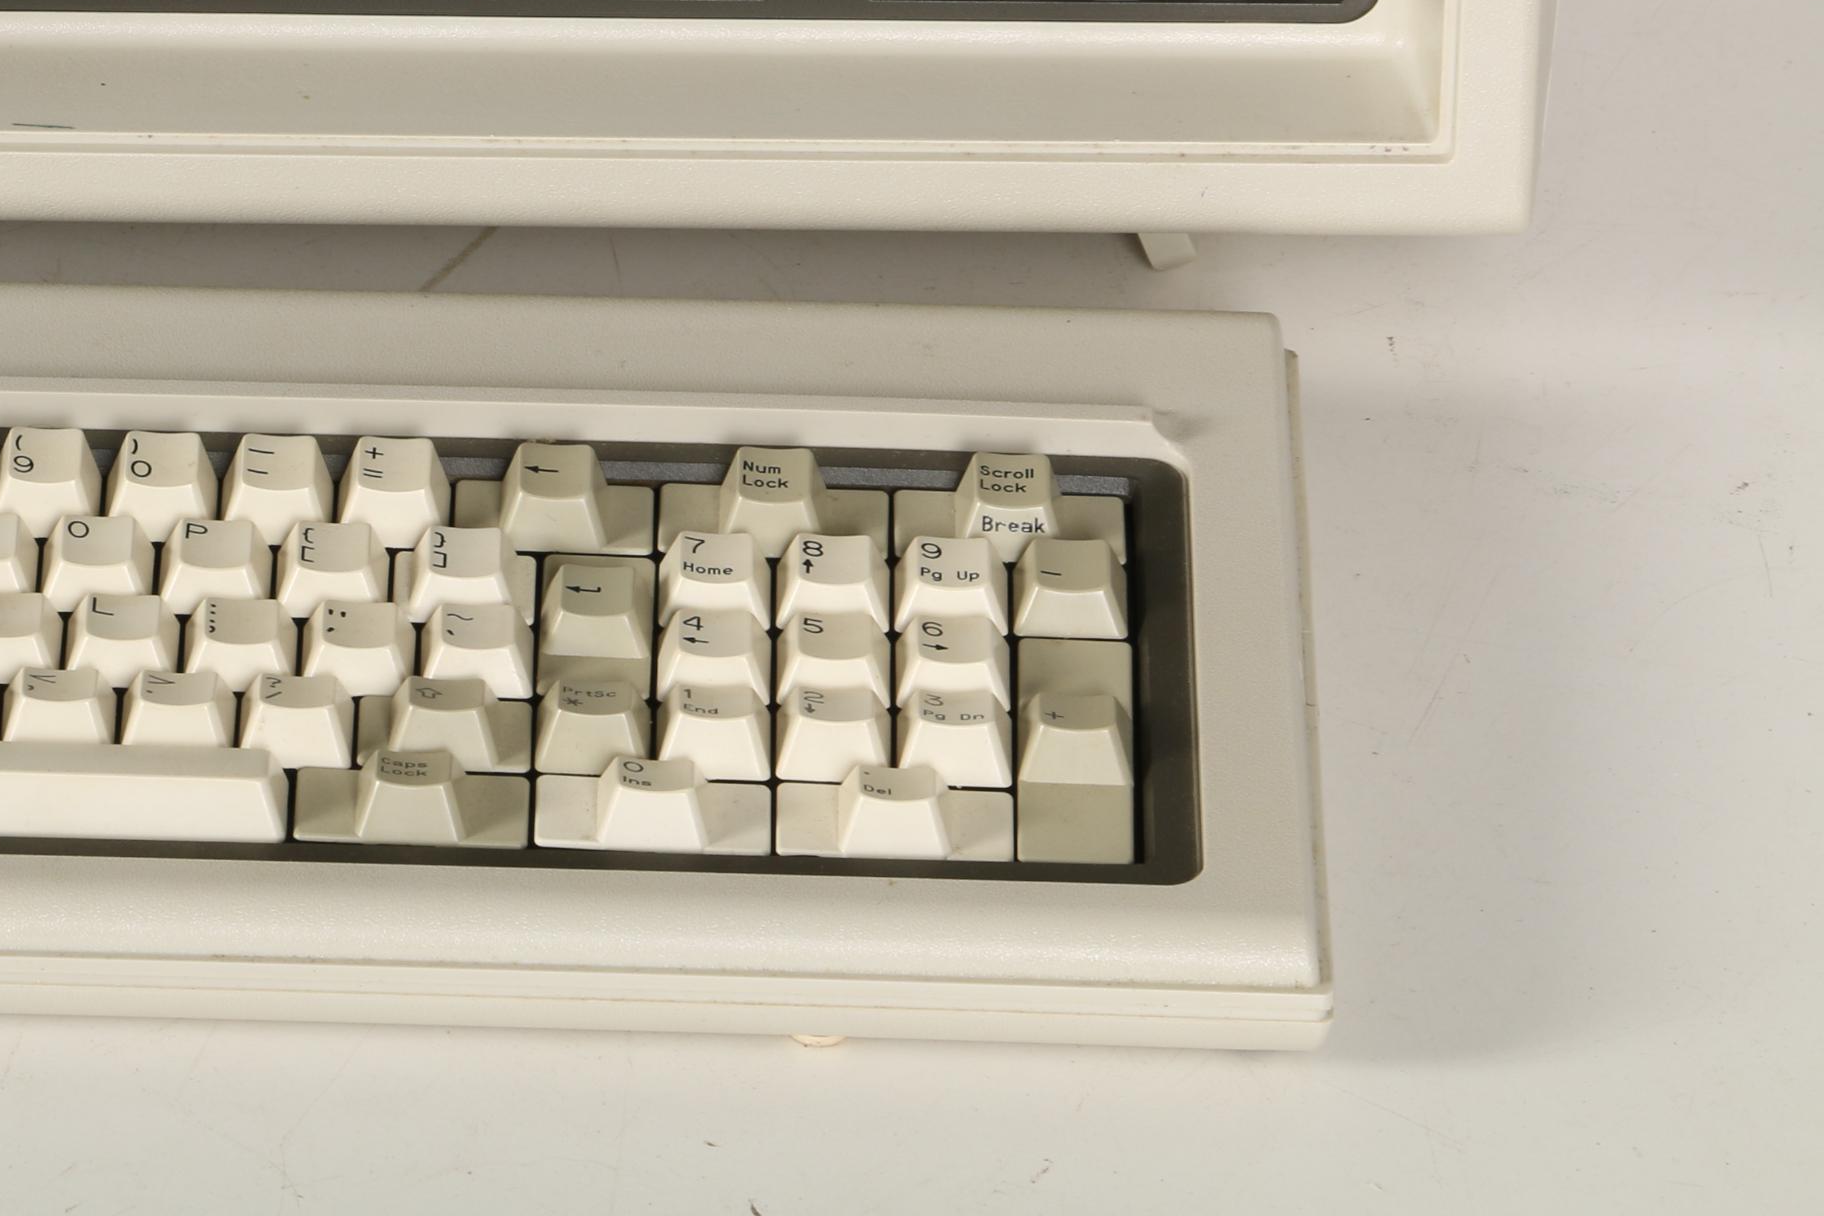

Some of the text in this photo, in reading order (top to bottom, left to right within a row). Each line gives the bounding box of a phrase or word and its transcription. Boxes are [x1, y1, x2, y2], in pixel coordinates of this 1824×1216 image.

[14, 456, 34, 473] 9
[131, 460, 152, 477] 0
[743, 460, 781, 474] Num
[980, 465, 1034, 479] Scroll
[742, 474, 788, 488] Lock
[980, 479, 1026, 492] Lock
[68, 521, 89, 538] O
[185, 523, 208, 538] P
[982, 516, 1044, 533] Break
[685, 536, 705, 553] 7
[803, 541, 823, 557] 8
[921, 543, 942, 559] 9
[683, 562, 733, 575] Home
[921, 567, 979, 582] Pg Up
[92, 597, 114, 616] L
[683, 616, 703, 631] 4
[803, 618, 823, 633] 5
[922, 622, 943, 636] 6
[563, 686, 616, 697] PrtSc
[684, 689, 691, 698] 1
[803, 691, 824, 704] 2
[924, 694, 944, 706] 3
[683, 704, 718, 714] End
[923, 709, 945, 721] Pg
[381, 757, 427, 769] Caps
[623, 761, 644, 772] 0
[381, 766, 427, 776] Lock
[623, 776, 651, 786] Ins
[864, 785, 891, 795] Del
